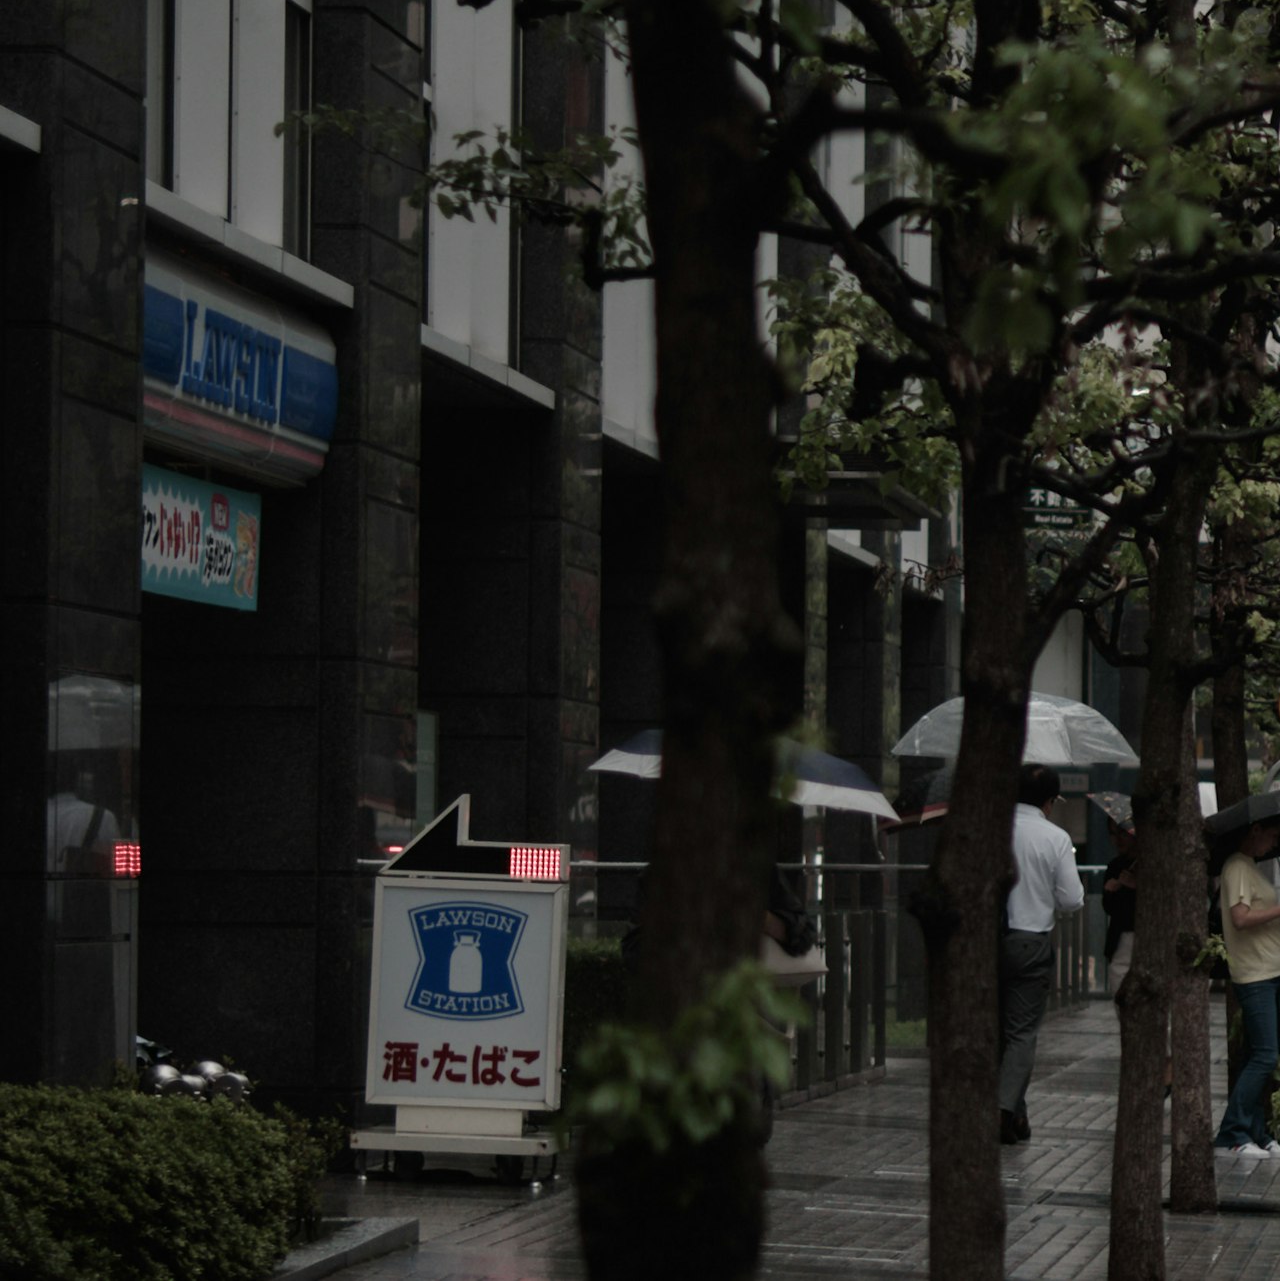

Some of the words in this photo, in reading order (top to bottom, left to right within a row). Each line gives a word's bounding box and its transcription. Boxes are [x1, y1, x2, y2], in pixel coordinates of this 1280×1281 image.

[182, 298, 282, 424] LAWSON
[420, 909, 516, 934] LAWSON
[418, 989, 511, 1013] STATION
[382, 1040, 541, 1088] 酒・たばこ
